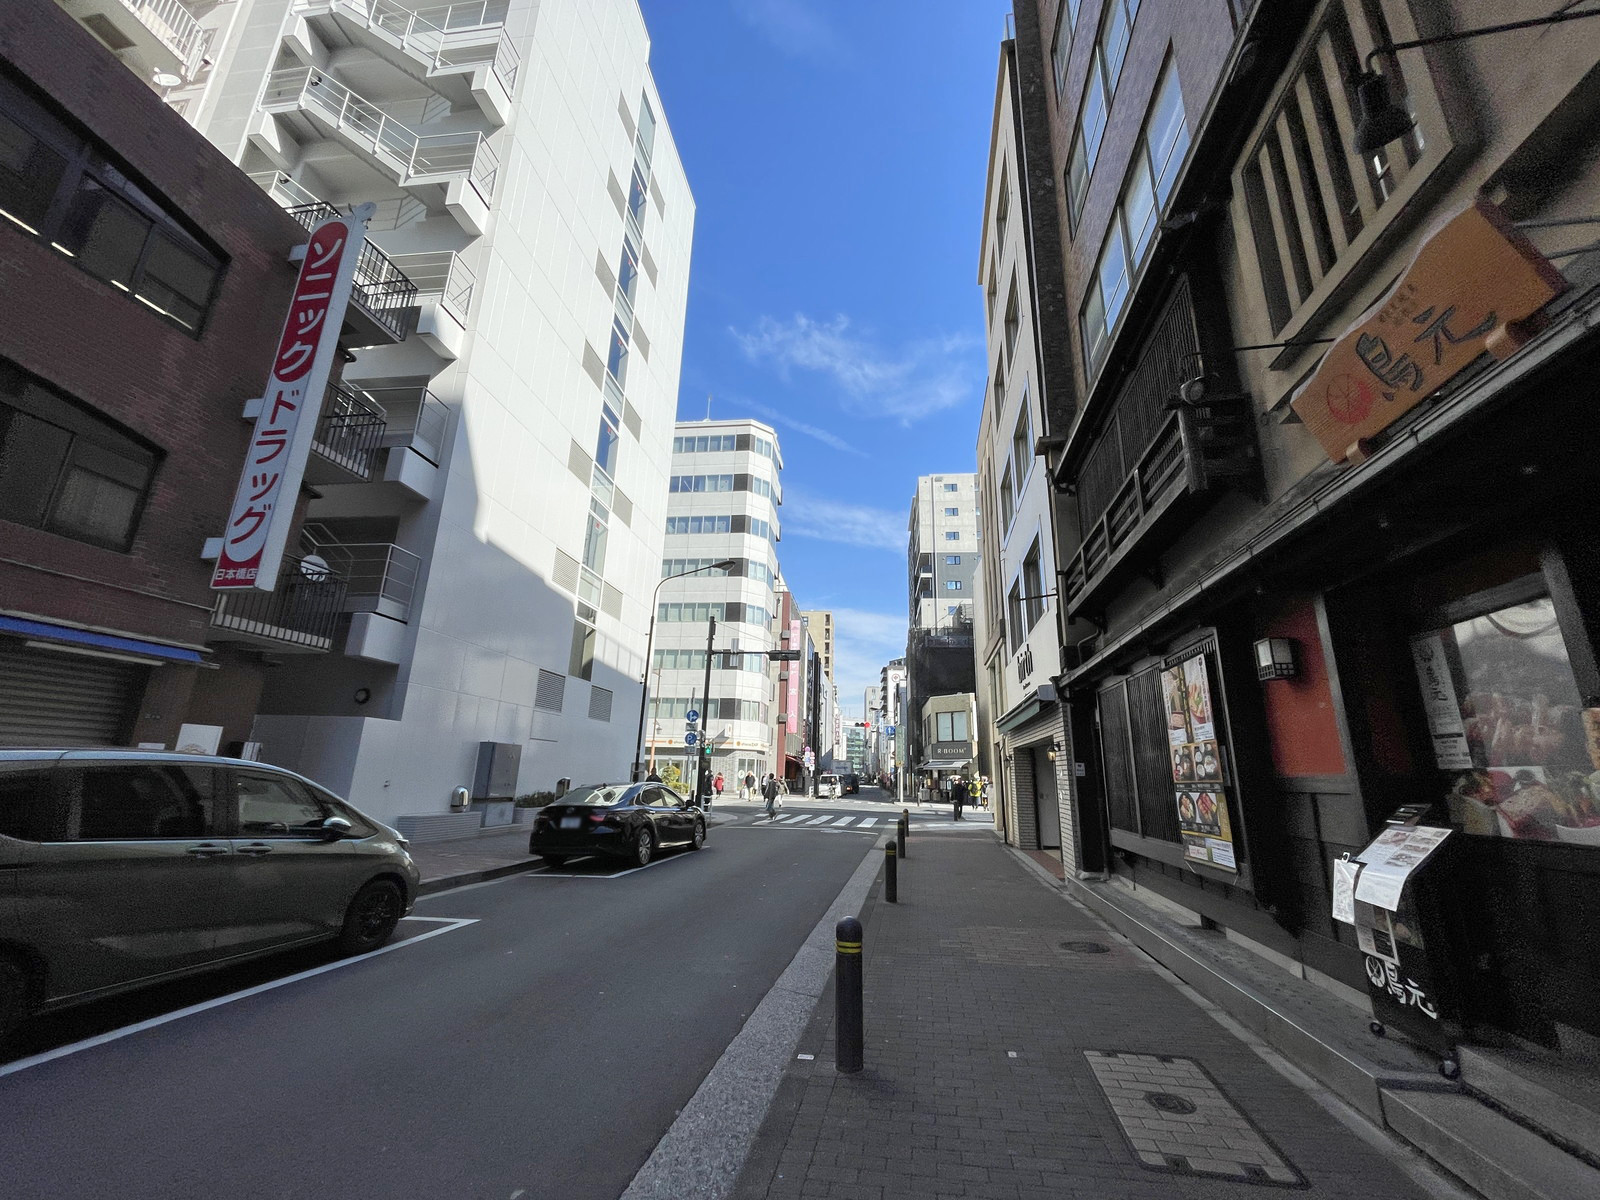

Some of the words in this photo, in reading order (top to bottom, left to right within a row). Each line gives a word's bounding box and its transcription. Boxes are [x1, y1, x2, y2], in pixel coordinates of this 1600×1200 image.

[231, 237, 343, 545] ソニックドラッグ
[215, 567, 258, 580] 日本橋店
[1017, 643, 1033, 684] birth
